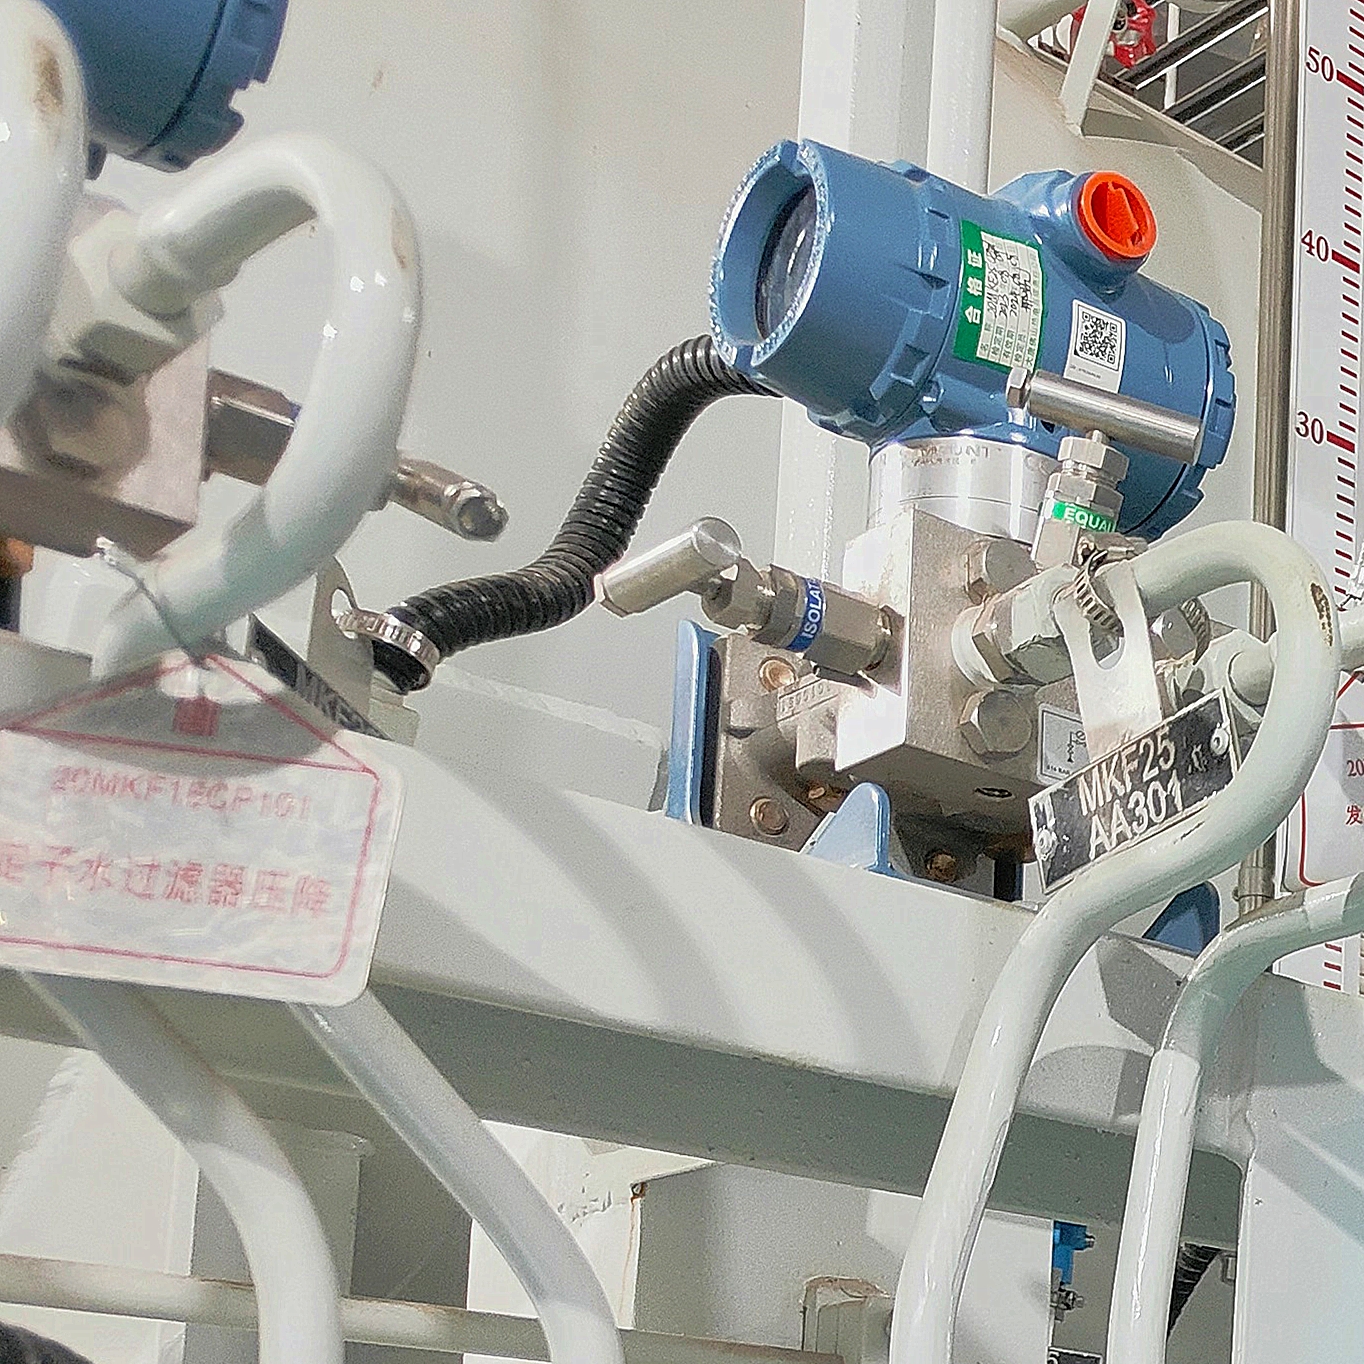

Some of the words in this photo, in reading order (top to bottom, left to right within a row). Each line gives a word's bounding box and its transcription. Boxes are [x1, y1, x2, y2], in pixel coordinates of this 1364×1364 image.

[1306, 47, 1334, 83] 50
[1301, 229, 1330, 263] 40
[965, 249, 982, 324] 合格证
[1295, 411, 1326, 445] 30
[1077, 726, 1177, 816] MKF25
[1088, 773, 1183, 859] AA301
